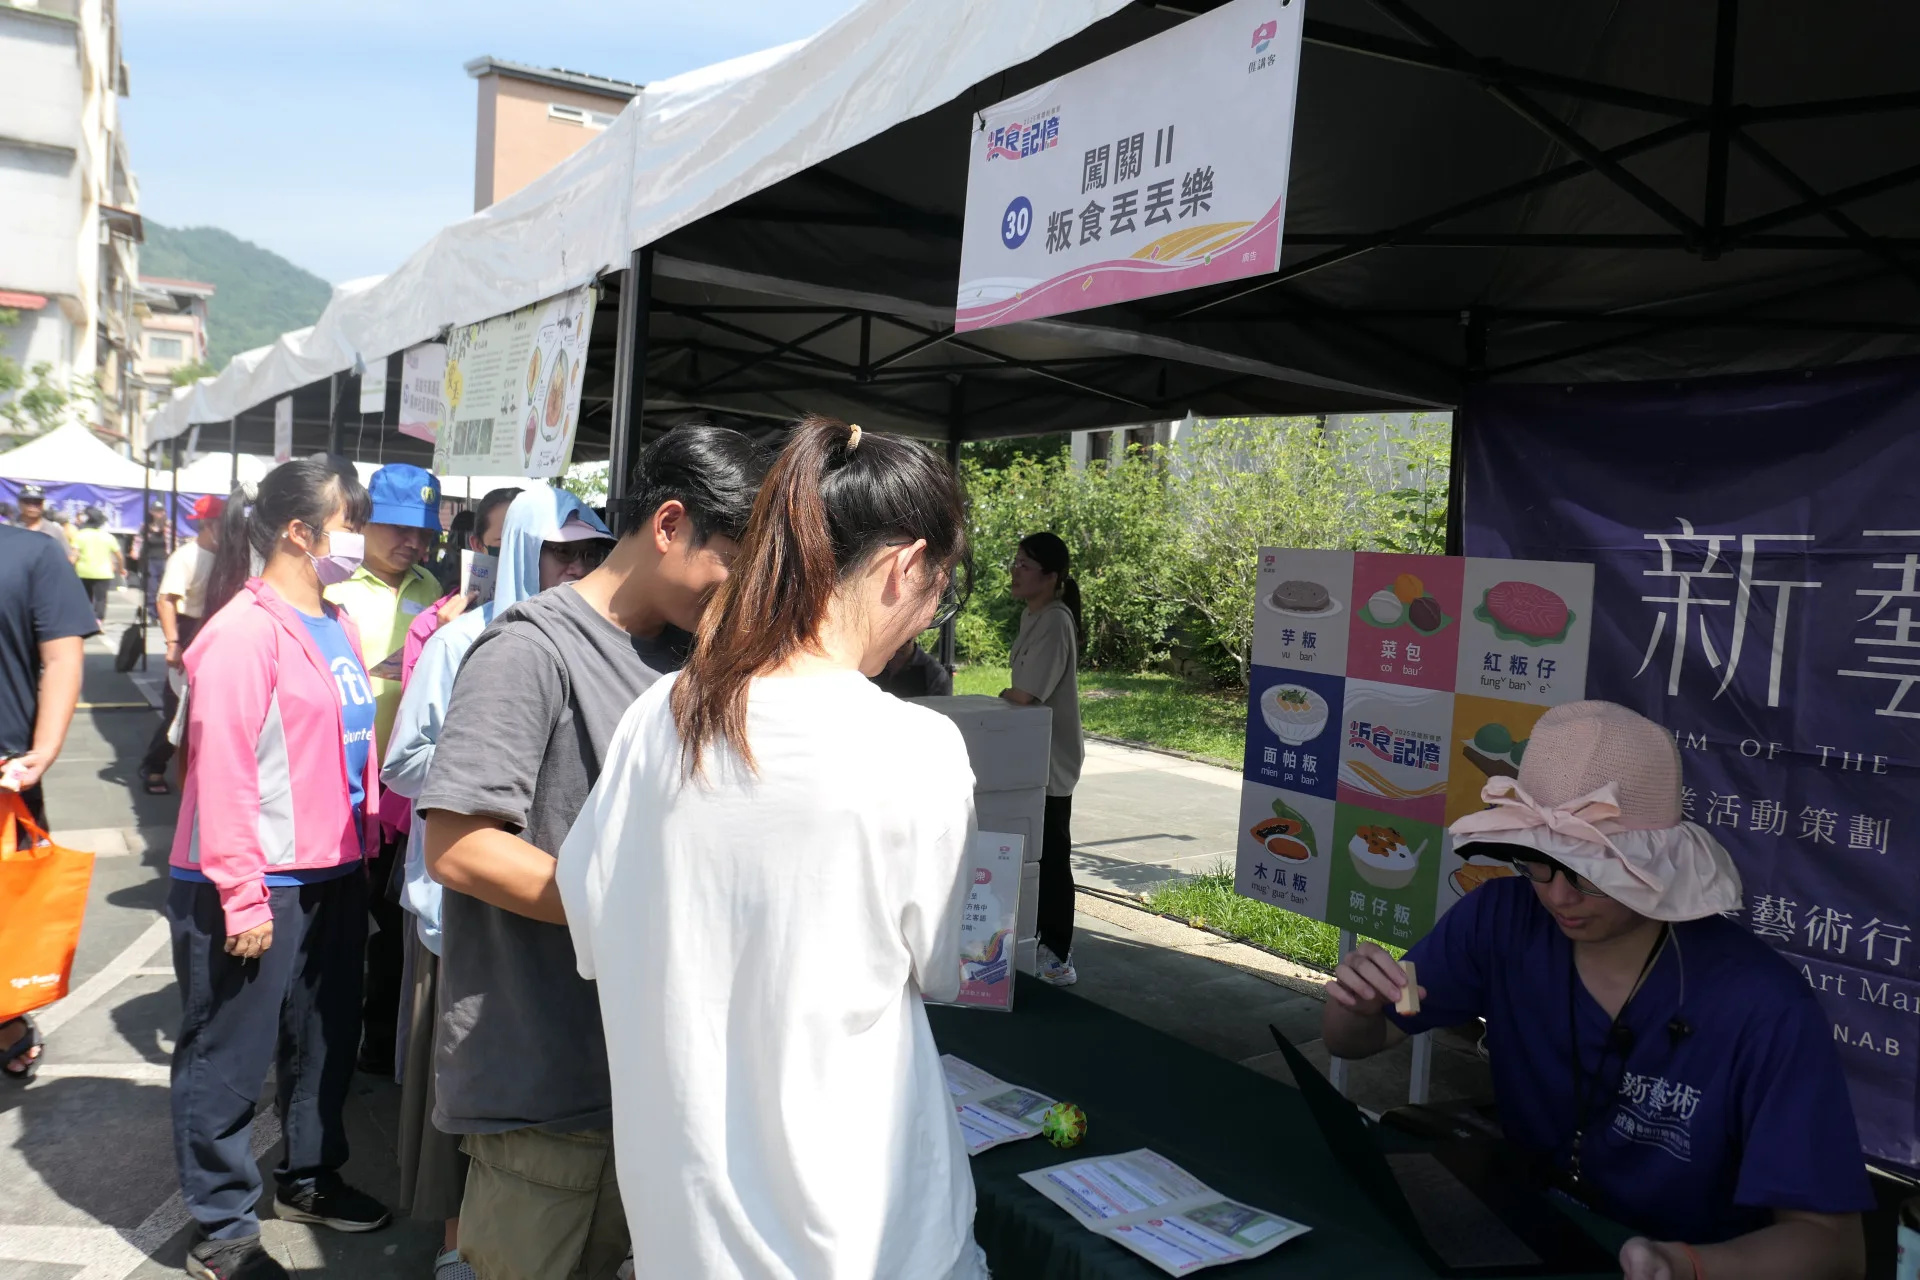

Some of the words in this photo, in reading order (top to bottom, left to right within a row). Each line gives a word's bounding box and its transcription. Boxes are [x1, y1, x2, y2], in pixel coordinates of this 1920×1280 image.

[1081, 132, 1145, 195] 闖關
[1006, 206, 1030, 240] 30
[1046, 165, 1216, 255] 粄食丟丟樂
[1282, 628, 1317, 649] 芋粄
[1381, 640, 1421, 662] 菜包
[1483, 651, 1556, 679] 紅粄仔
[1263, 746, 1317, 774] 面帕粄
[1675, 729, 1708, 751] M
[1739, 738, 1783, 760] OF
[1815, 744, 1888, 775] THE
[1254, 862, 1308, 894] 木瓜粄
[1349, 890, 1411, 926] 碗仔粄
[1721, 894, 1912, 967] 藝術行
[1801, 964, 1847, 997] Art
[1833, 1023, 1900, 1057] N.A.B
